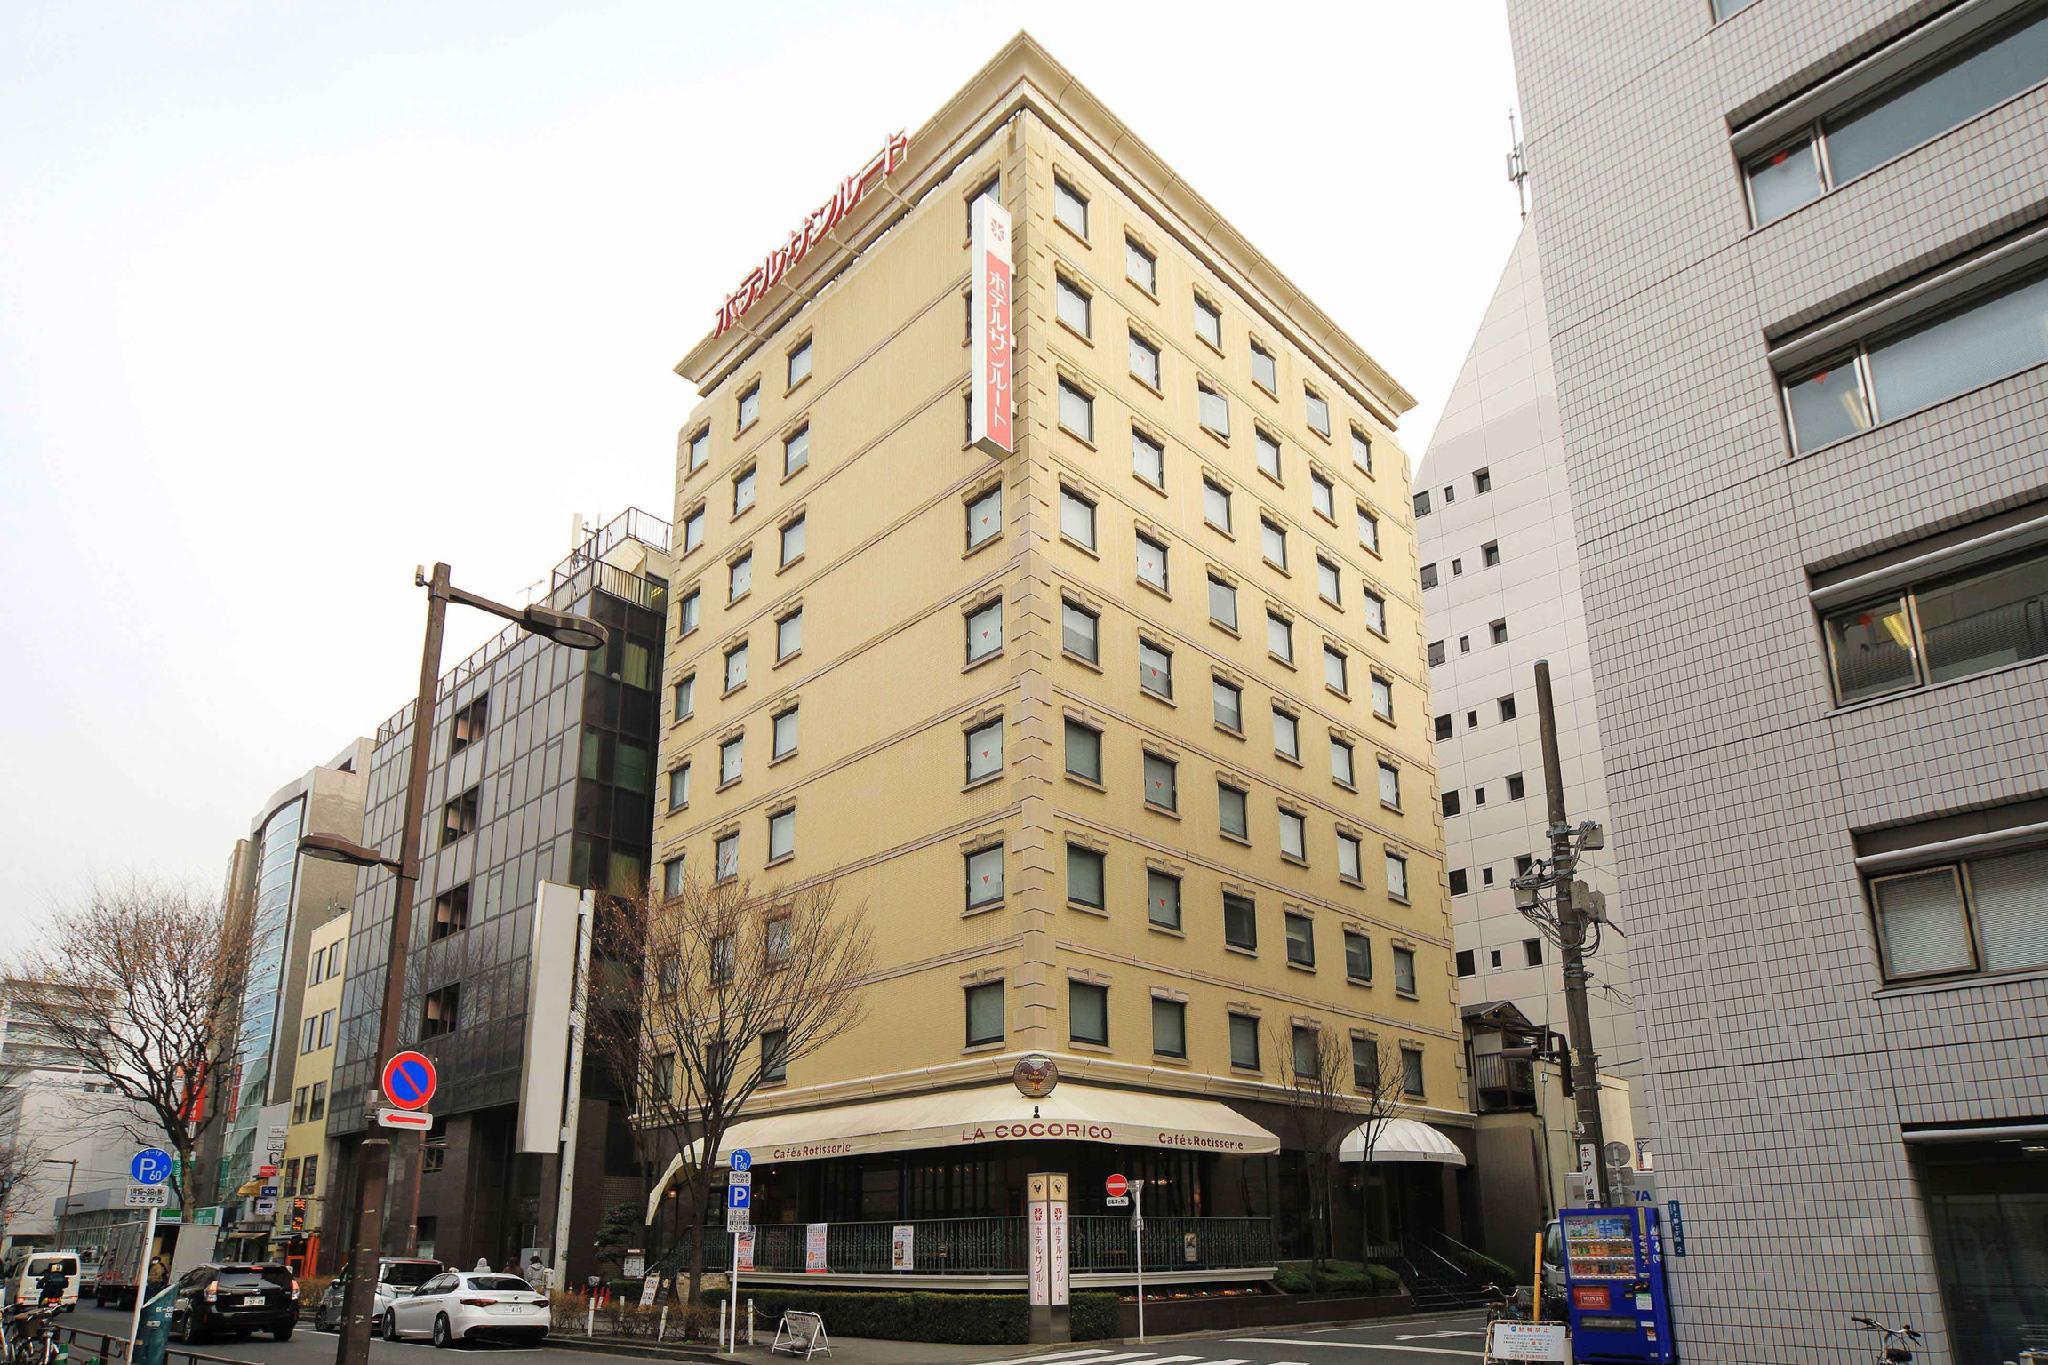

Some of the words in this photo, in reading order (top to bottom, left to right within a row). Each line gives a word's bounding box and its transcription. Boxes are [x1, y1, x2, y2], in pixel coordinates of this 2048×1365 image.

[713, 133, 908, 340] ホテルサンルート
[988, 270, 1008, 429] ホテルサンルート
[961, 1128, 986, 1141] LA
[994, 1122, 1113, 1140] COCORICO
[139, 1157, 157, 1180] P
[735, 1154, 743, 1170] P
[149, 1170, 162, 1181] 60
[129, 1196, 164, 1204] ここから
[733, 1186, 747, 1206] P
[1035, 1226, 1043, 1302] ホテルサンルート
[1055, 1226, 1064, 1302] ホテルサンルート
